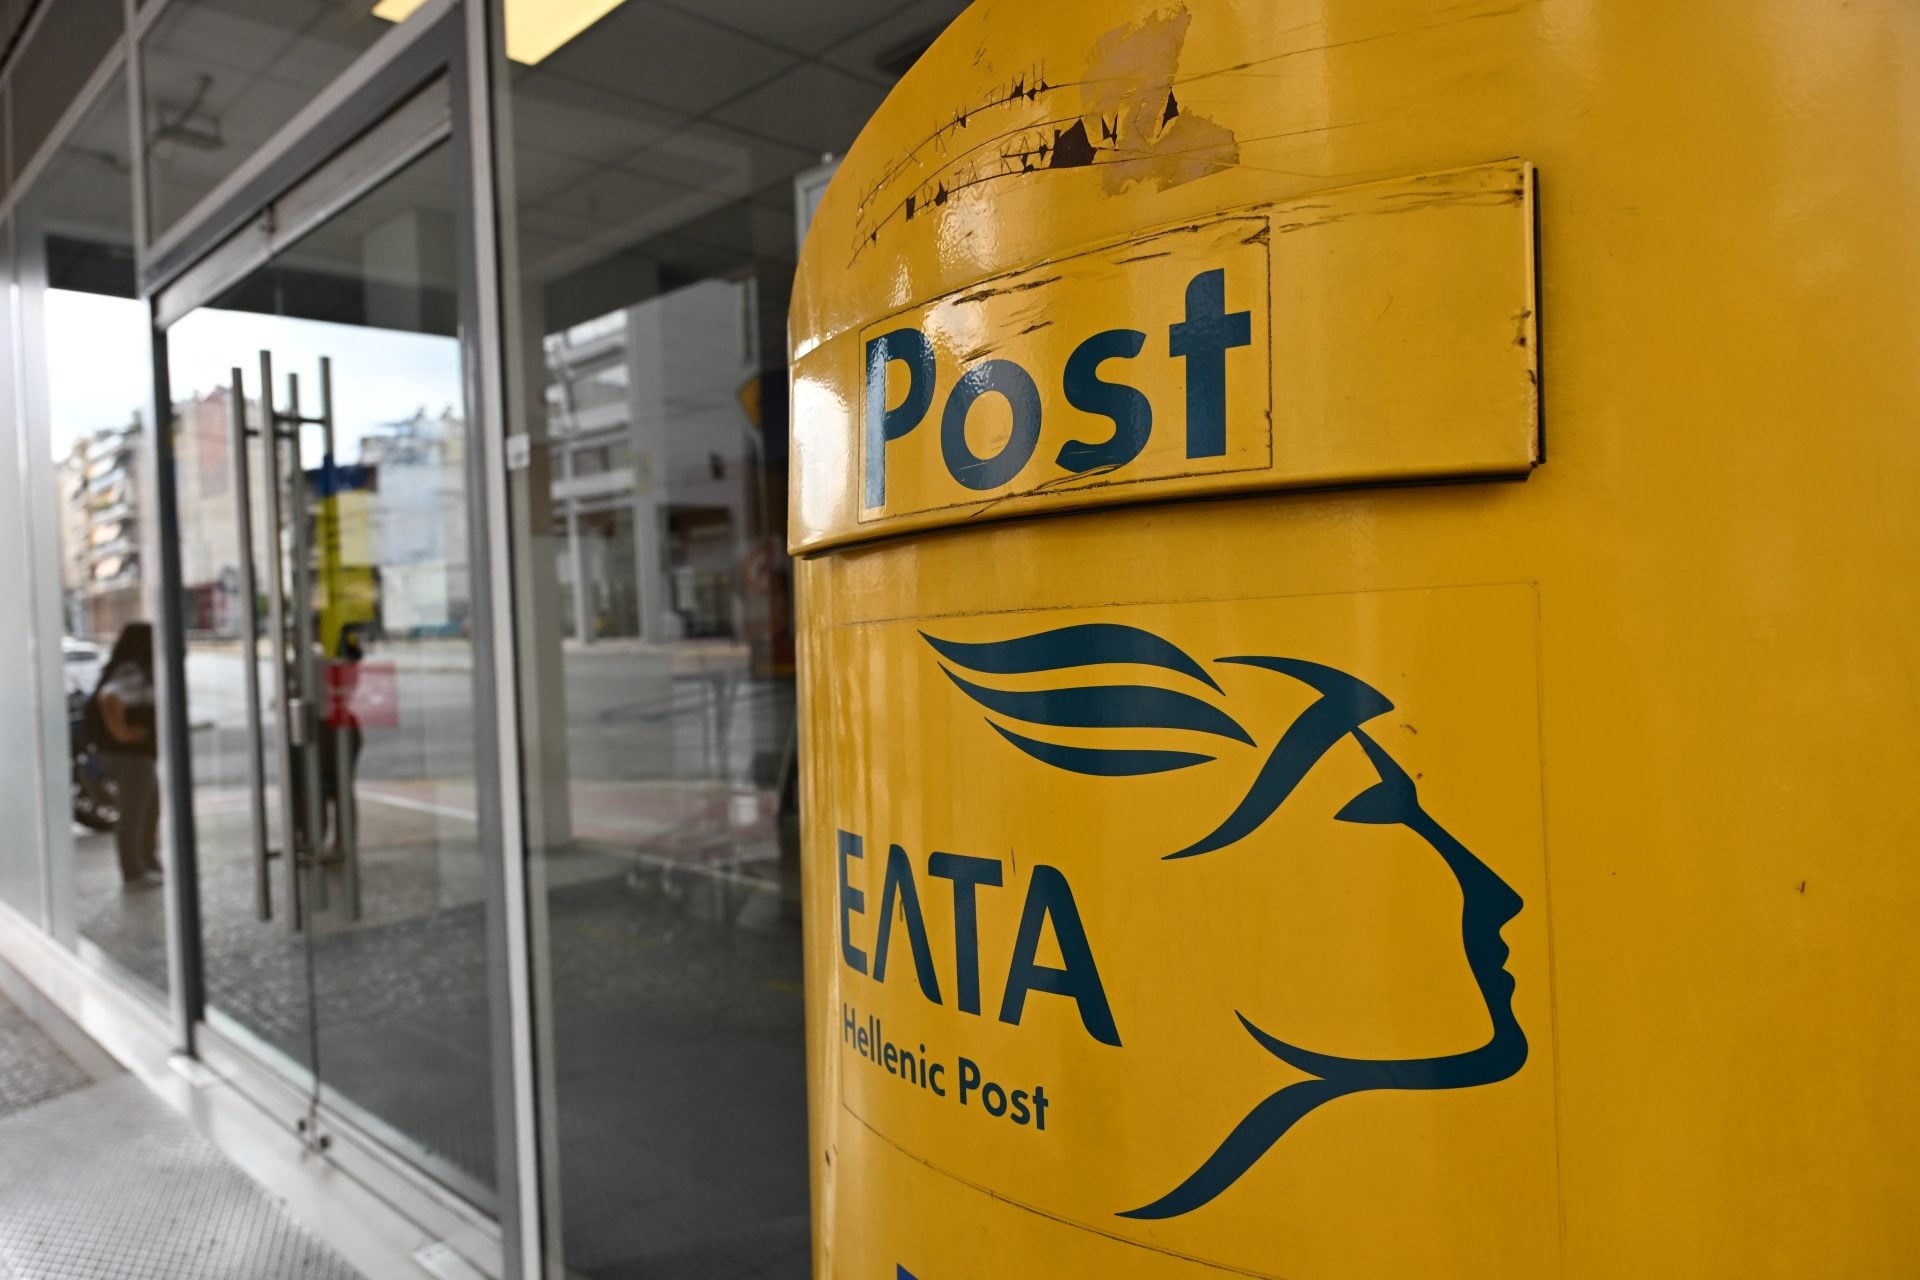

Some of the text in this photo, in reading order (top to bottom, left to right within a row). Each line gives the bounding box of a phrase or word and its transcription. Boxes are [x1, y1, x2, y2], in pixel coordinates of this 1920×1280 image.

[864, 269, 1252, 509] Post
[839, 830, 1121, 1047] ΕΛΤΑ
[843, 1002, 1049, 1130] Hellenic Post
